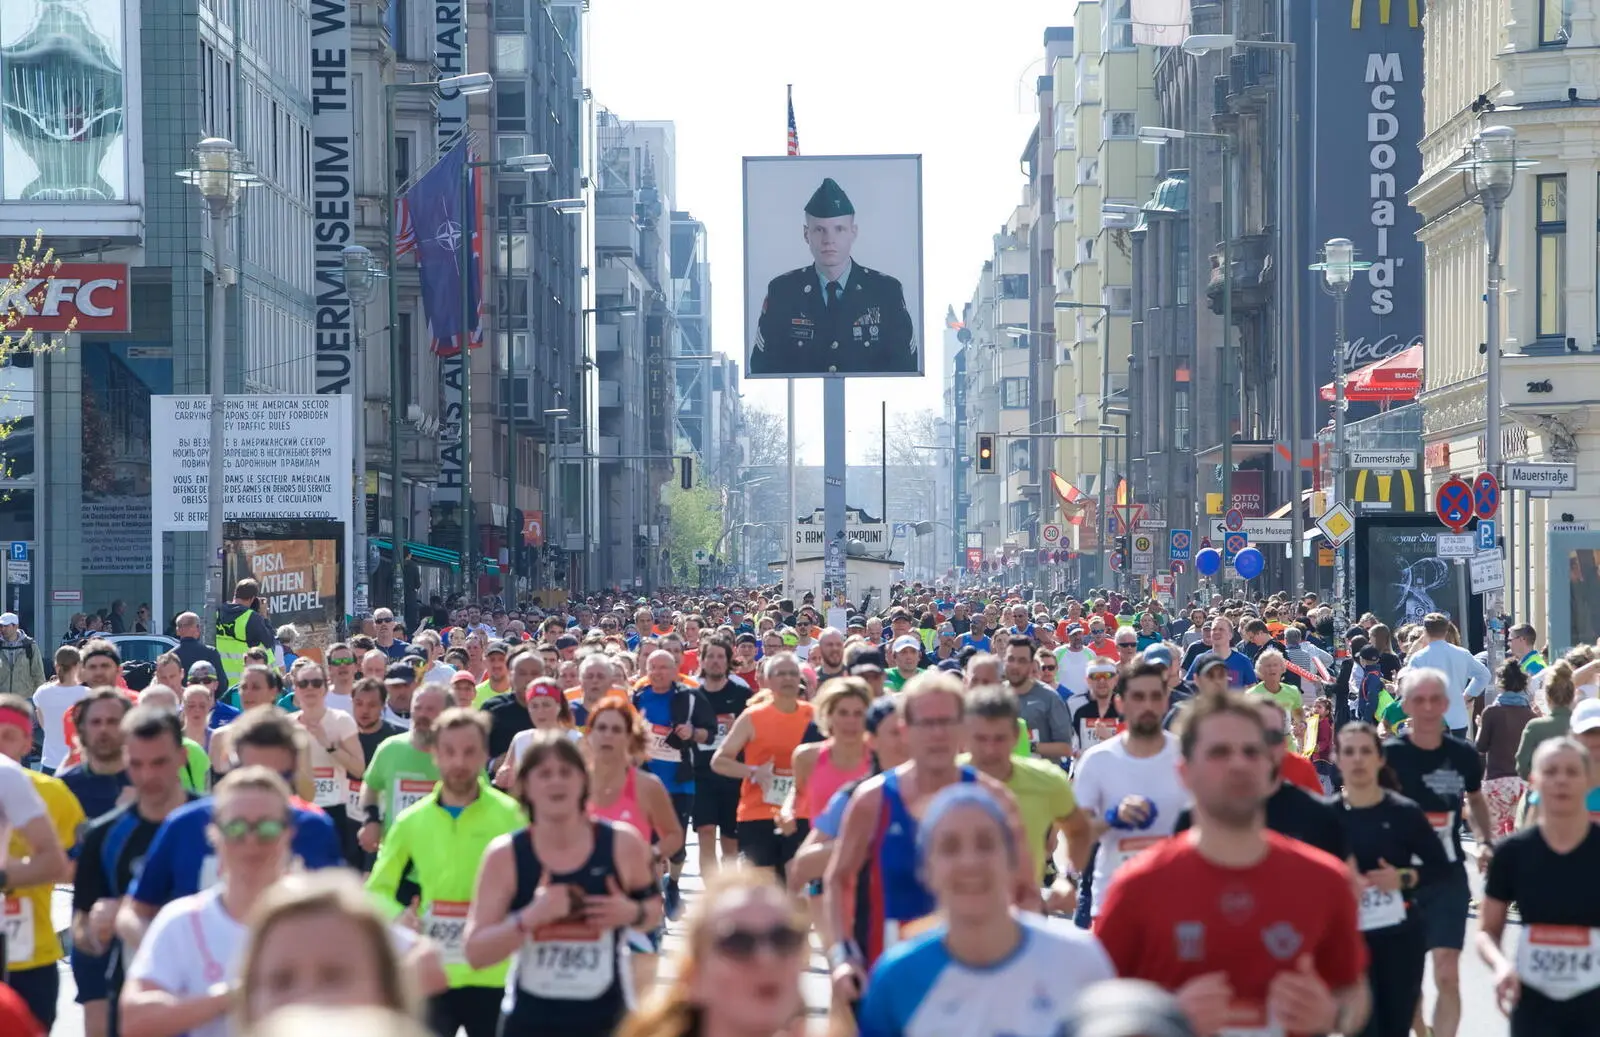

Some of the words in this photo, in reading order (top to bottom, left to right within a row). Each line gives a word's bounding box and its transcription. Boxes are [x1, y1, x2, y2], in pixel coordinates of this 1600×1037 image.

[435, 0, 461, 101] CHAR
[312, 47, 347, 116] THE
[1364, 52, 1404, 315] McDonald's
[315, 136, 350, 395] AUERMUSEUM
[0, 277, 118, 317] KFC
[650, 335, 661, 417] HOTEL
[175, 401, 190, 410] YOU
[193, 401, 206, 410] ARE
[247, 400, 259, 410] THE
[262, 400, 299, 409] AMERICAN
[302, 400, 329, 409] SECTOR
[174, 411, 212, 420] CARRYING
[225, 411, 249, 420] APONS
[251, 411, 265, 420] OFF
[268, 411, 286, 420] DUTY
[289, 410, 329, 420] FORBIDDEN
[237, 421, 266, 430] TRAFFIC
[268, 421, 291, 431] RULES
[179, 438, 190, 448] ВЫ
[233, 438, 238, 447] В
[300, 437, 326, 447] СЕКТОР
[261, 448, 265, 457] В
[311, 448, 332, 457] ВРЕМЯ
[235, 459, 277, 468] ДОРОЖНЫМ
[1354, 453, 1411, 466] Zimmerstraße
[174, 474, 192, 484] VOUS
[224, 474, 243, 484] DANS
[247, 474, 254, 483] LE
[257, 474, 288, 484] SECTEUR
[1512, 468, 1568, 484] Mauerstraße
[198, 485, 207, 494] DE
[230, 485, 241, 494] DES
[242, 485, 262, 493] ARMES
[263, 485, 271, 493] EN
[273, 485, 296, 493] DEHORS
[298, 485, 306, 493] DU
[307, 484, 332, 493] SERVICE
[182, 495, 208, 504] OBEISS
[237, 495, 262, 504] REGLES
[265, 495, 274, 504] DE
[278, 495, 323, 504] CIRCULATION
[174, 511, 185, 521] SIE
[188, 511, 209, 521] BETRE
[223, 511, 238, 519] DEN
[241, 511, 301, 519] AMERIKANISCHEN
[303, 510, 330, 519] SEKTOR
[796, 531, 802, 543] S
[1047, 529, 1056, 538] 30
[1481, 523, 1491, 546] P
[1139, 540, 1147, 548] H
[1399, 535, 1419, 545] your
[14, 543, 24, 558] P
[1172, 550, 1189, 558] TAXI
[252, 552, 285, 573] PISA
[260, 571, 304, 594] ATHEN
[269, 591, 323, 614] NEAPEL
